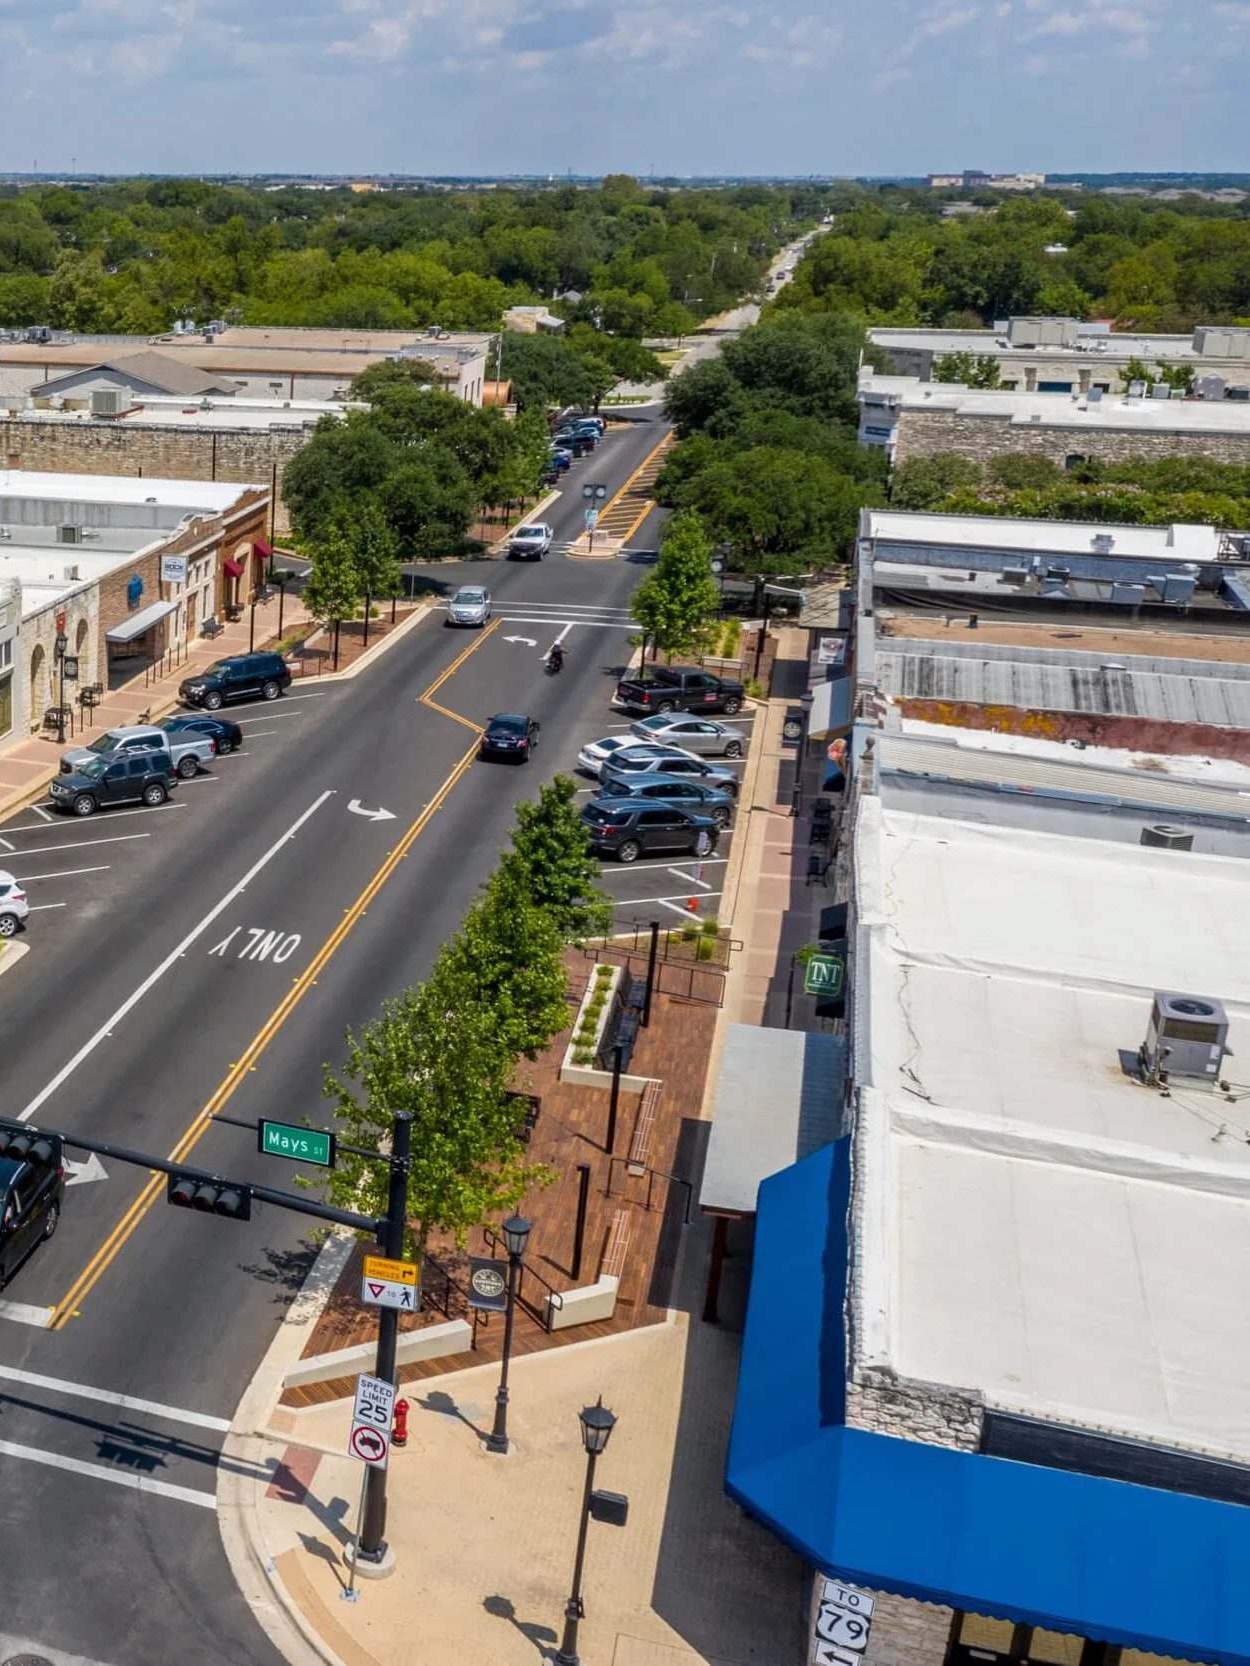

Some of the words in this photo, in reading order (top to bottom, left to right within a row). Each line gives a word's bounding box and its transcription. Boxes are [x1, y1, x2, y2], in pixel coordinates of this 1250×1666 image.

[207, 926, 302, 963] ONLY
[812, 961, 841, 983] TNT
[269, 1130, 309, 1152] Mays
[368, 1268, 400, 1280] VEHICLES
[369, 1258, 400, 1271] TURNING
[360, 1379, 393, 1398] SPEED
[362, 1390, 388, 1406] LIMIT
[358, 1400, 388, 1424] 25
[837, 1588, 860, 1607] TO
[825, 1609, 863, 1640] 79
